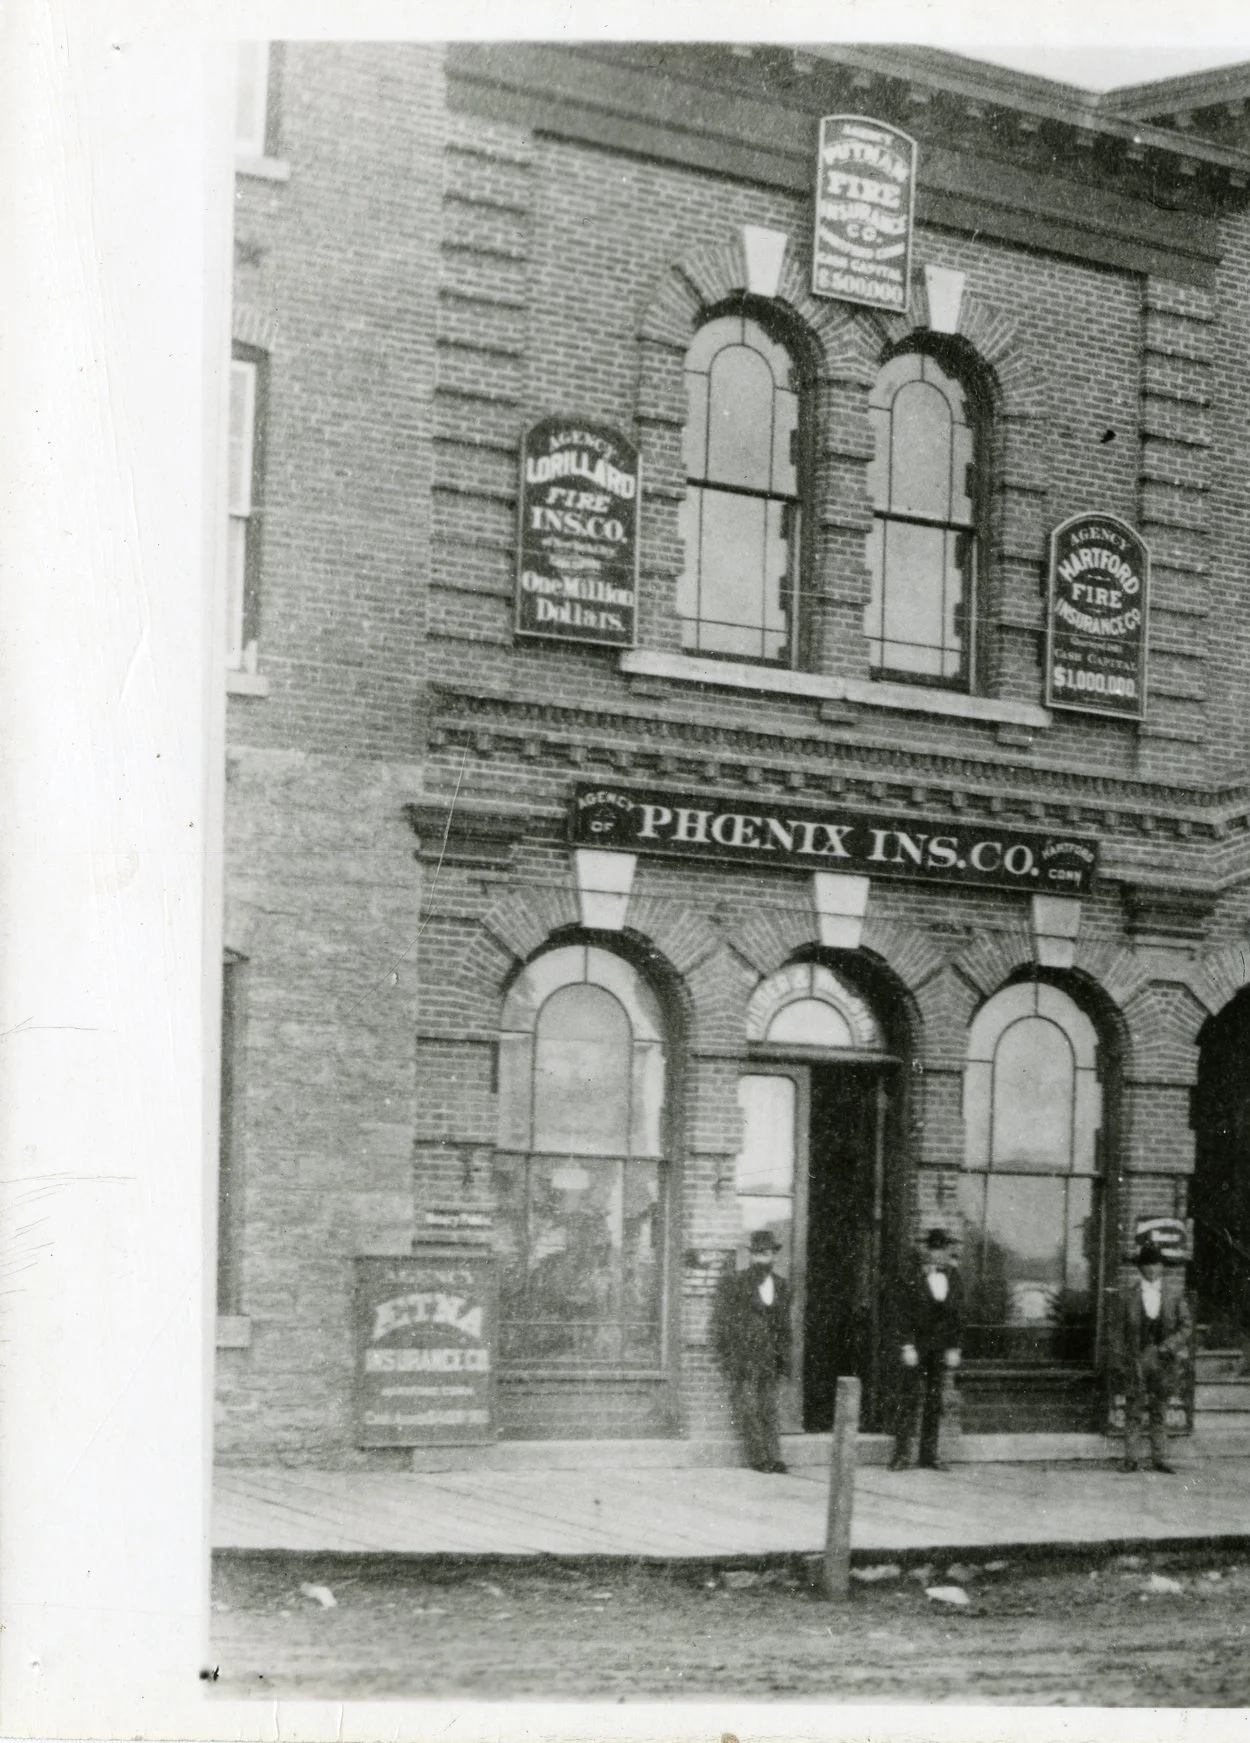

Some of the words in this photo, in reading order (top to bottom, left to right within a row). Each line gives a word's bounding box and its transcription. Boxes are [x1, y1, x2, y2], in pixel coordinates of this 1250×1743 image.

[827, 170, 901, 209] FIRE
[526, 450, 636, 499] LORILLARD
[545, 486, 611, 513] FIRE
[1070, 527, 1132, 551] AGENCY
[1058, 548, 1140, 595] HARTFORD
[1072, 583, 1123, 609] FIRE
[1054, 598, 1127, 636] INSURANCE
[578, 791, 635, 812] AGENCY
[590, 820, 615, 832] OF
